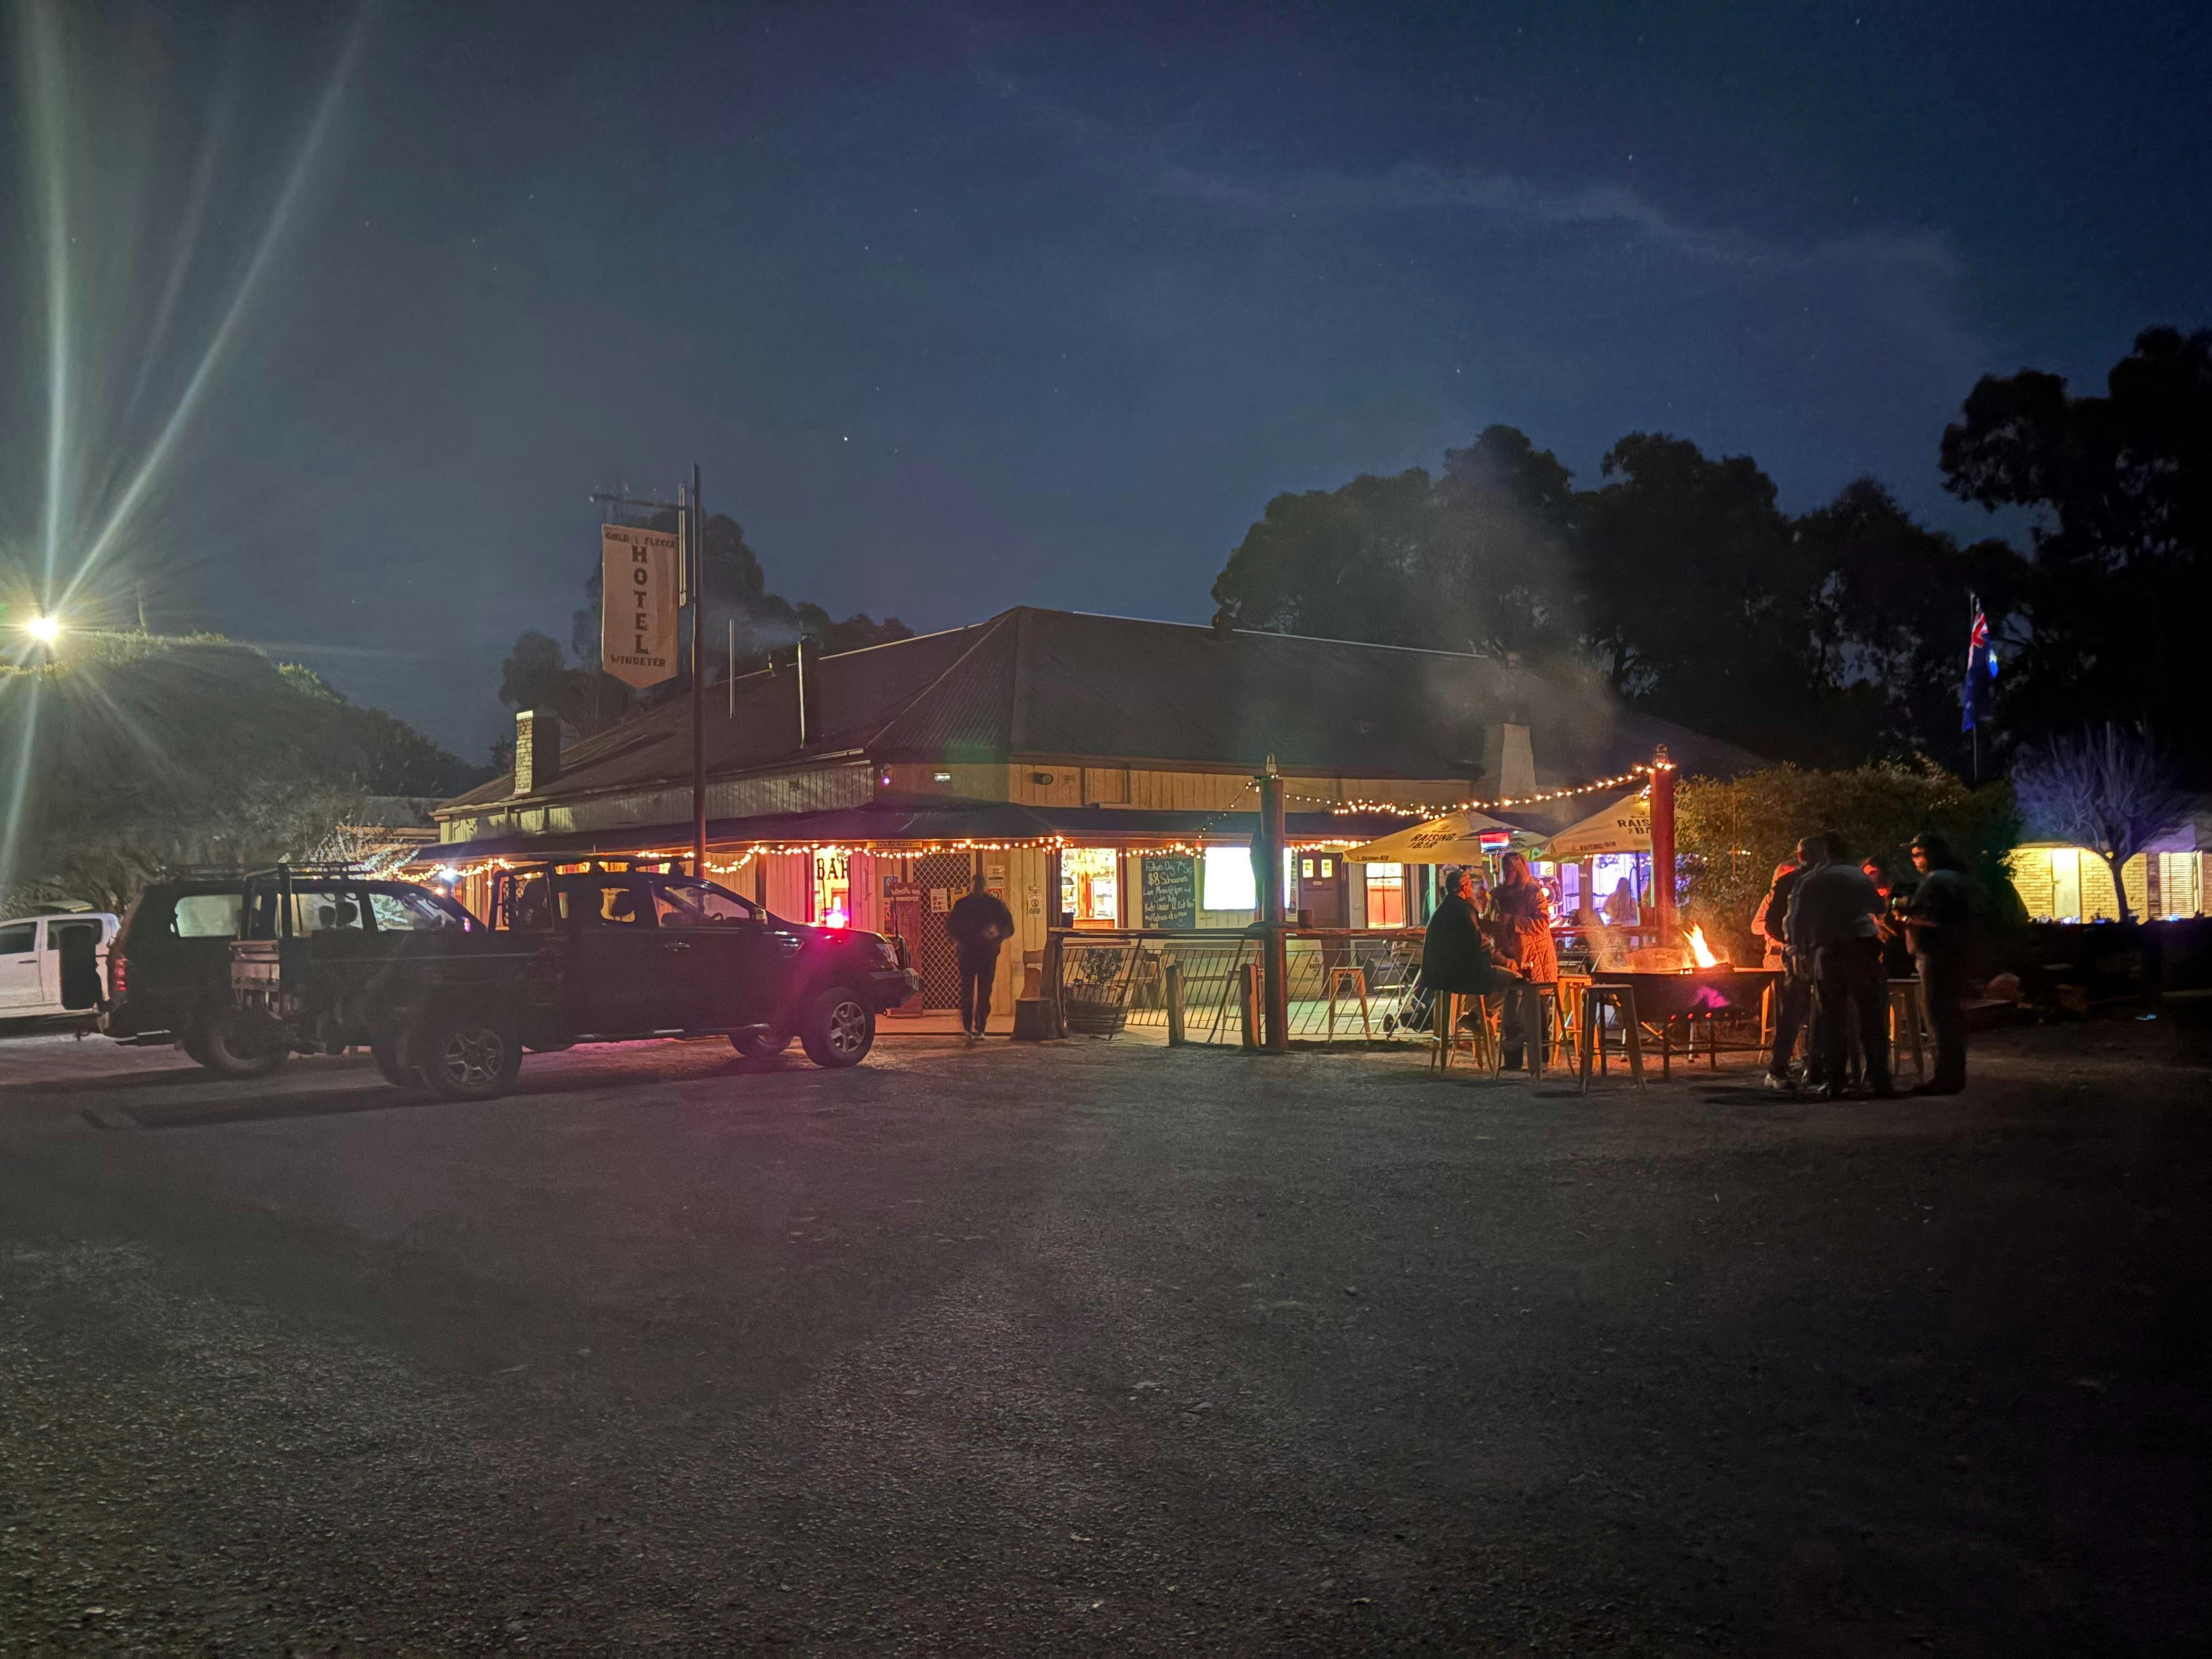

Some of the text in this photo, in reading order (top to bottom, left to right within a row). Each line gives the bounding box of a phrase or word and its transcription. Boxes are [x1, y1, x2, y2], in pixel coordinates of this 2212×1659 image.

[632, 545, 649, 654] HOTEL
[611, 654, 666, 668] WINDEYER
[1617, 819, 1651, 828] RAIS
[1410, 833, 1456, 842] RAISING
[1412, 841, 1438, 849] BAR
[1148, 871, 1160, 886] $8
